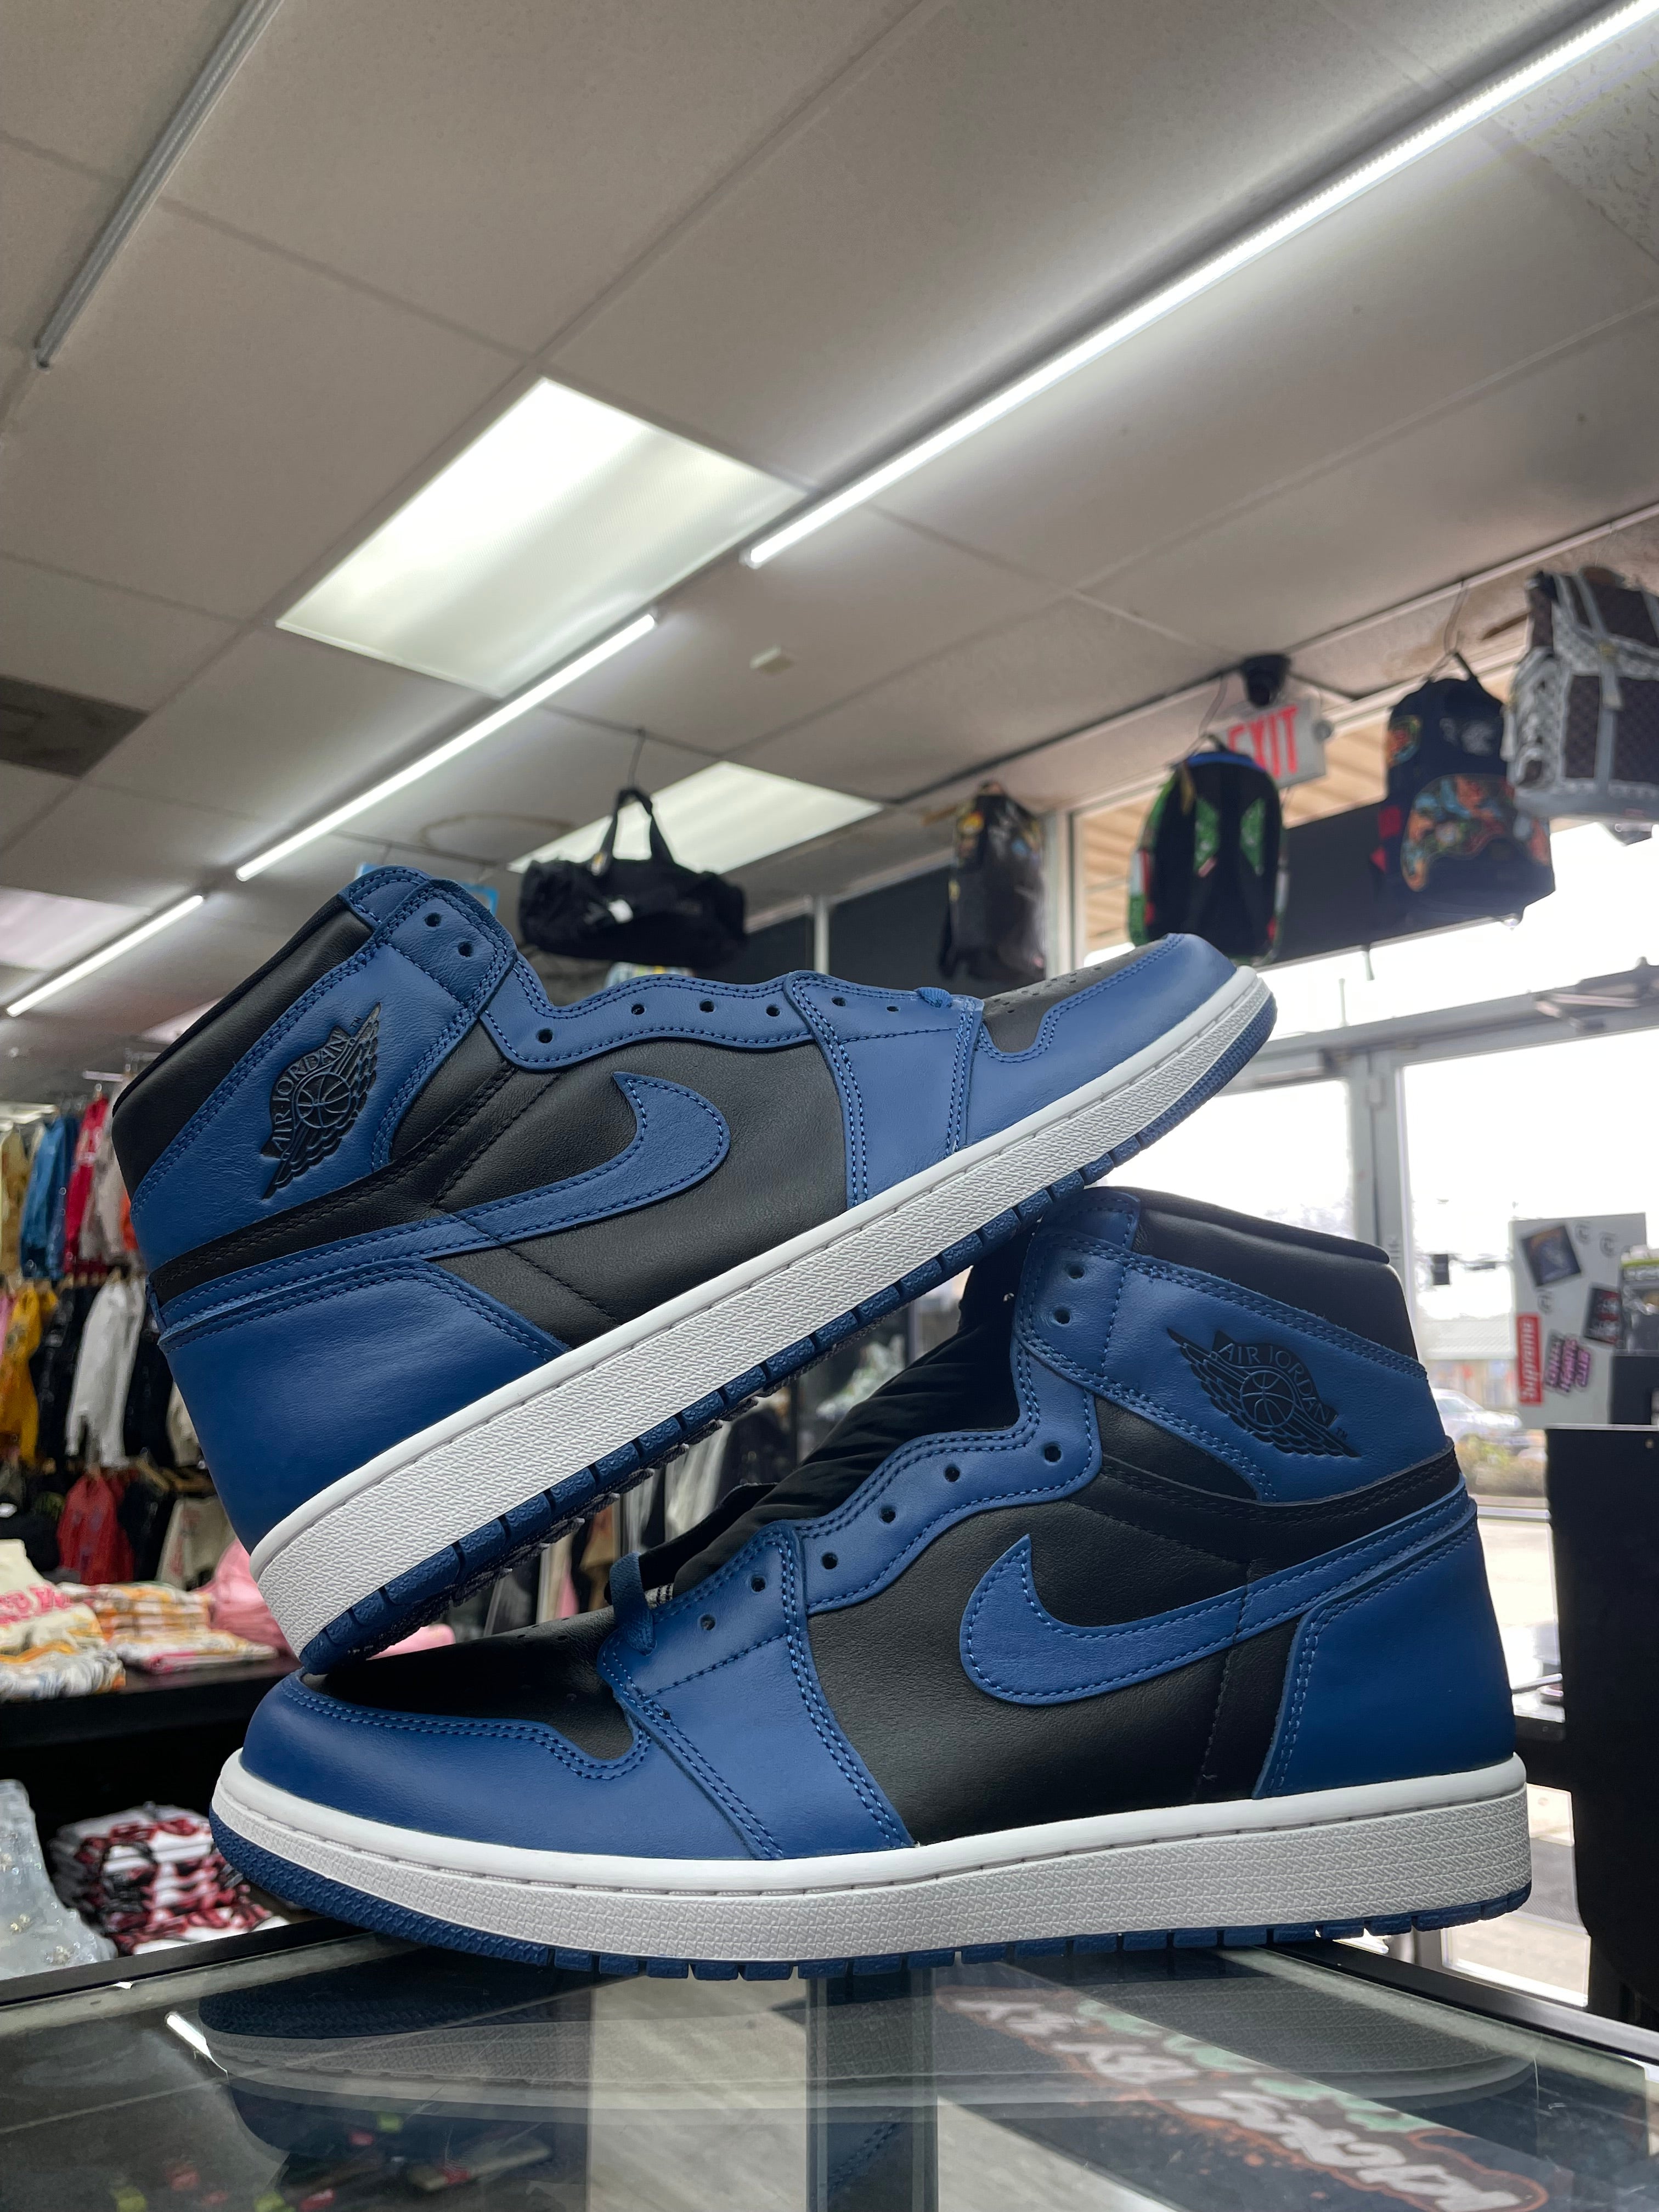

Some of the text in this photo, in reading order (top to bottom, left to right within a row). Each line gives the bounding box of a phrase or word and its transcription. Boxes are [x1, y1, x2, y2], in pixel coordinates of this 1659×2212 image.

[272, 1033, 351, 1151] AIR JORDAN
[1217, 1342, 1330, 1423] AIR JORDAN
